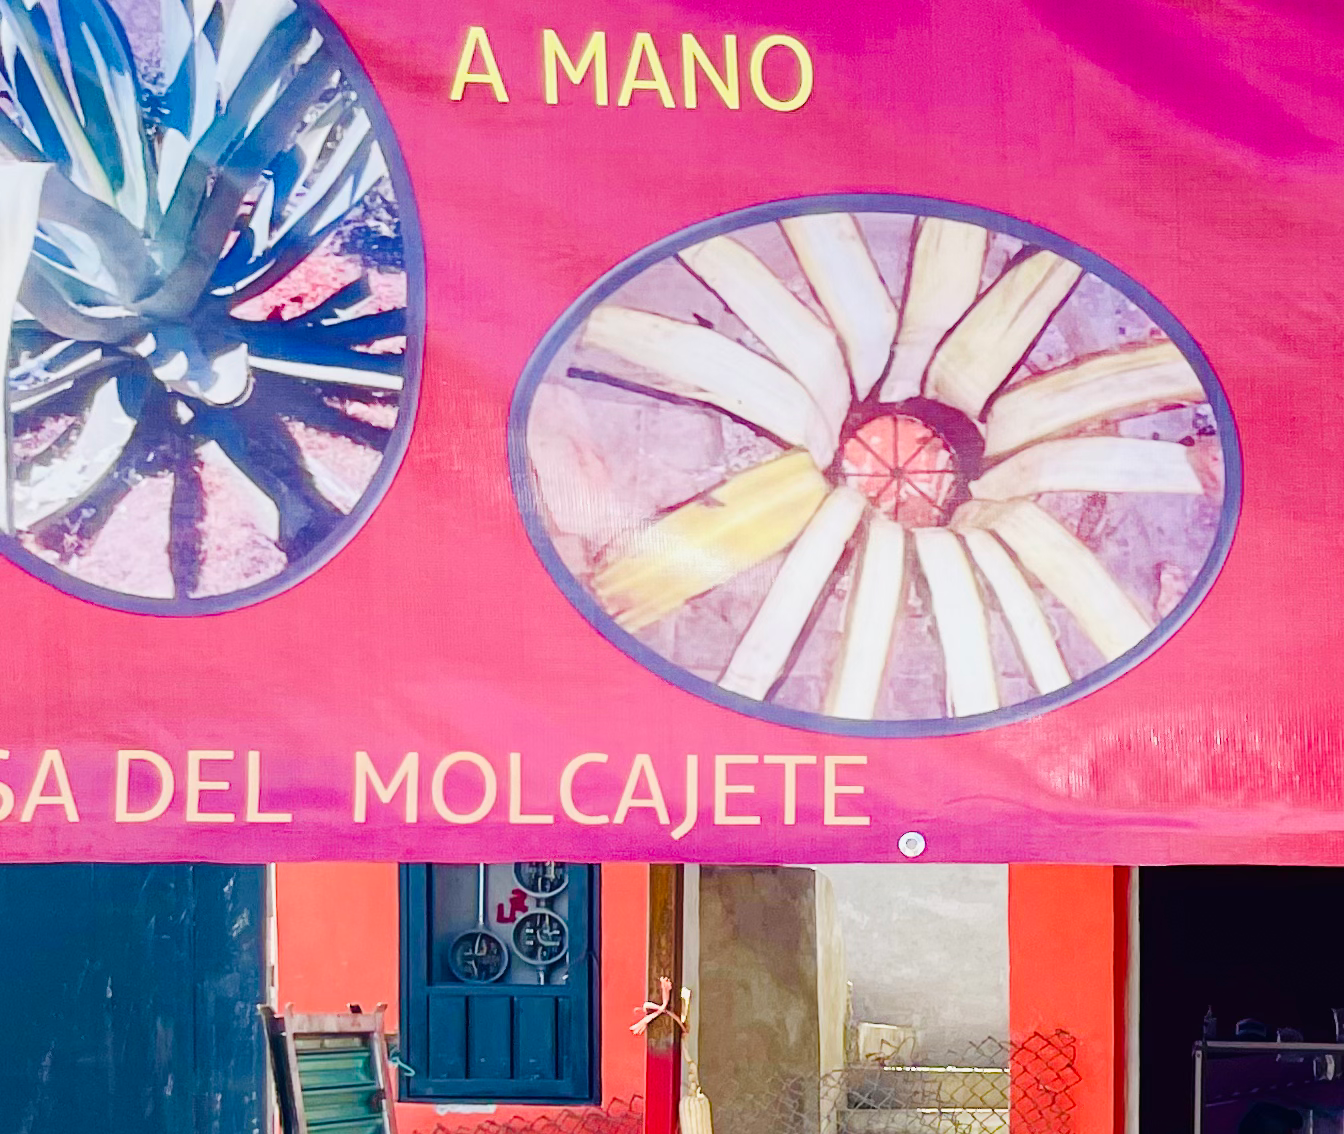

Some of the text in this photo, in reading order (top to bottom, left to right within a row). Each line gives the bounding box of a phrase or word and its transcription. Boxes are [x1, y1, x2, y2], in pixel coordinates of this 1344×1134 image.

[449, 25, 814, 112] A MANO
[115, 749, 293, 823] DEL
[353, 751, 871, 841] MOLCAJETE
